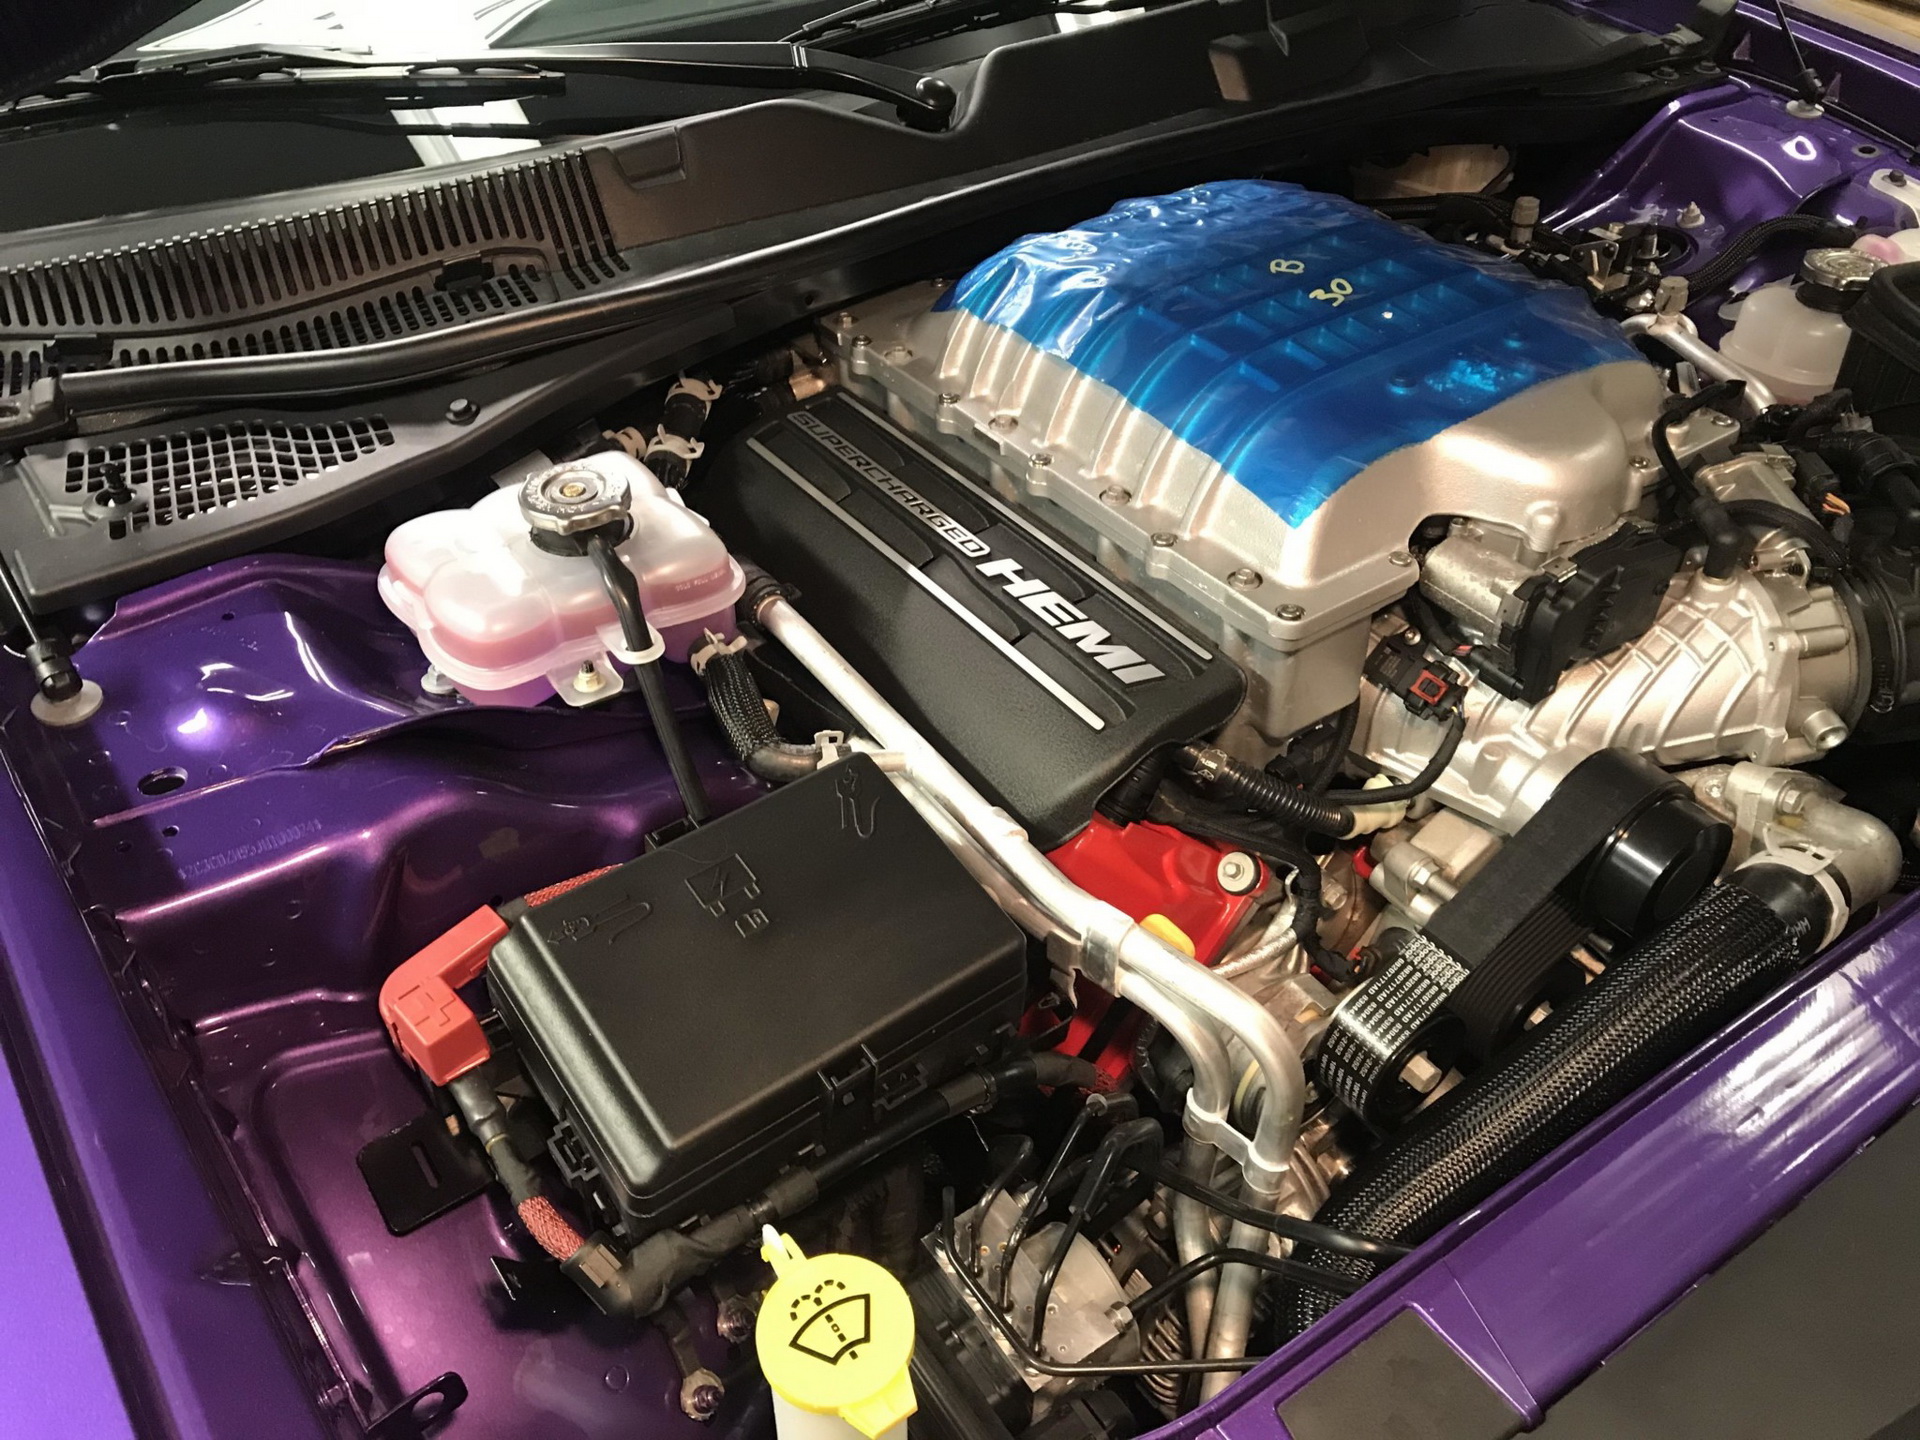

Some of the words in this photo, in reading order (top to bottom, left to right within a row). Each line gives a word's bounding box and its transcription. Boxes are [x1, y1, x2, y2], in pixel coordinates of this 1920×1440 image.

[1270, 258, 1305, 274] B
[1308, 278, 1353, 307] 30
[789, 412, 988, 557] SUPERCHARGED
[975, 558, 1165, 685] HEMI
[1405, 935, 1428, 958] mopar
[1413, 942, 1436, 965] mopar
[1422, 949, 1445, 972] mopar
[1430, 955, 1453, 979] mopar
[1439, 962, 1462, 985] mopar
